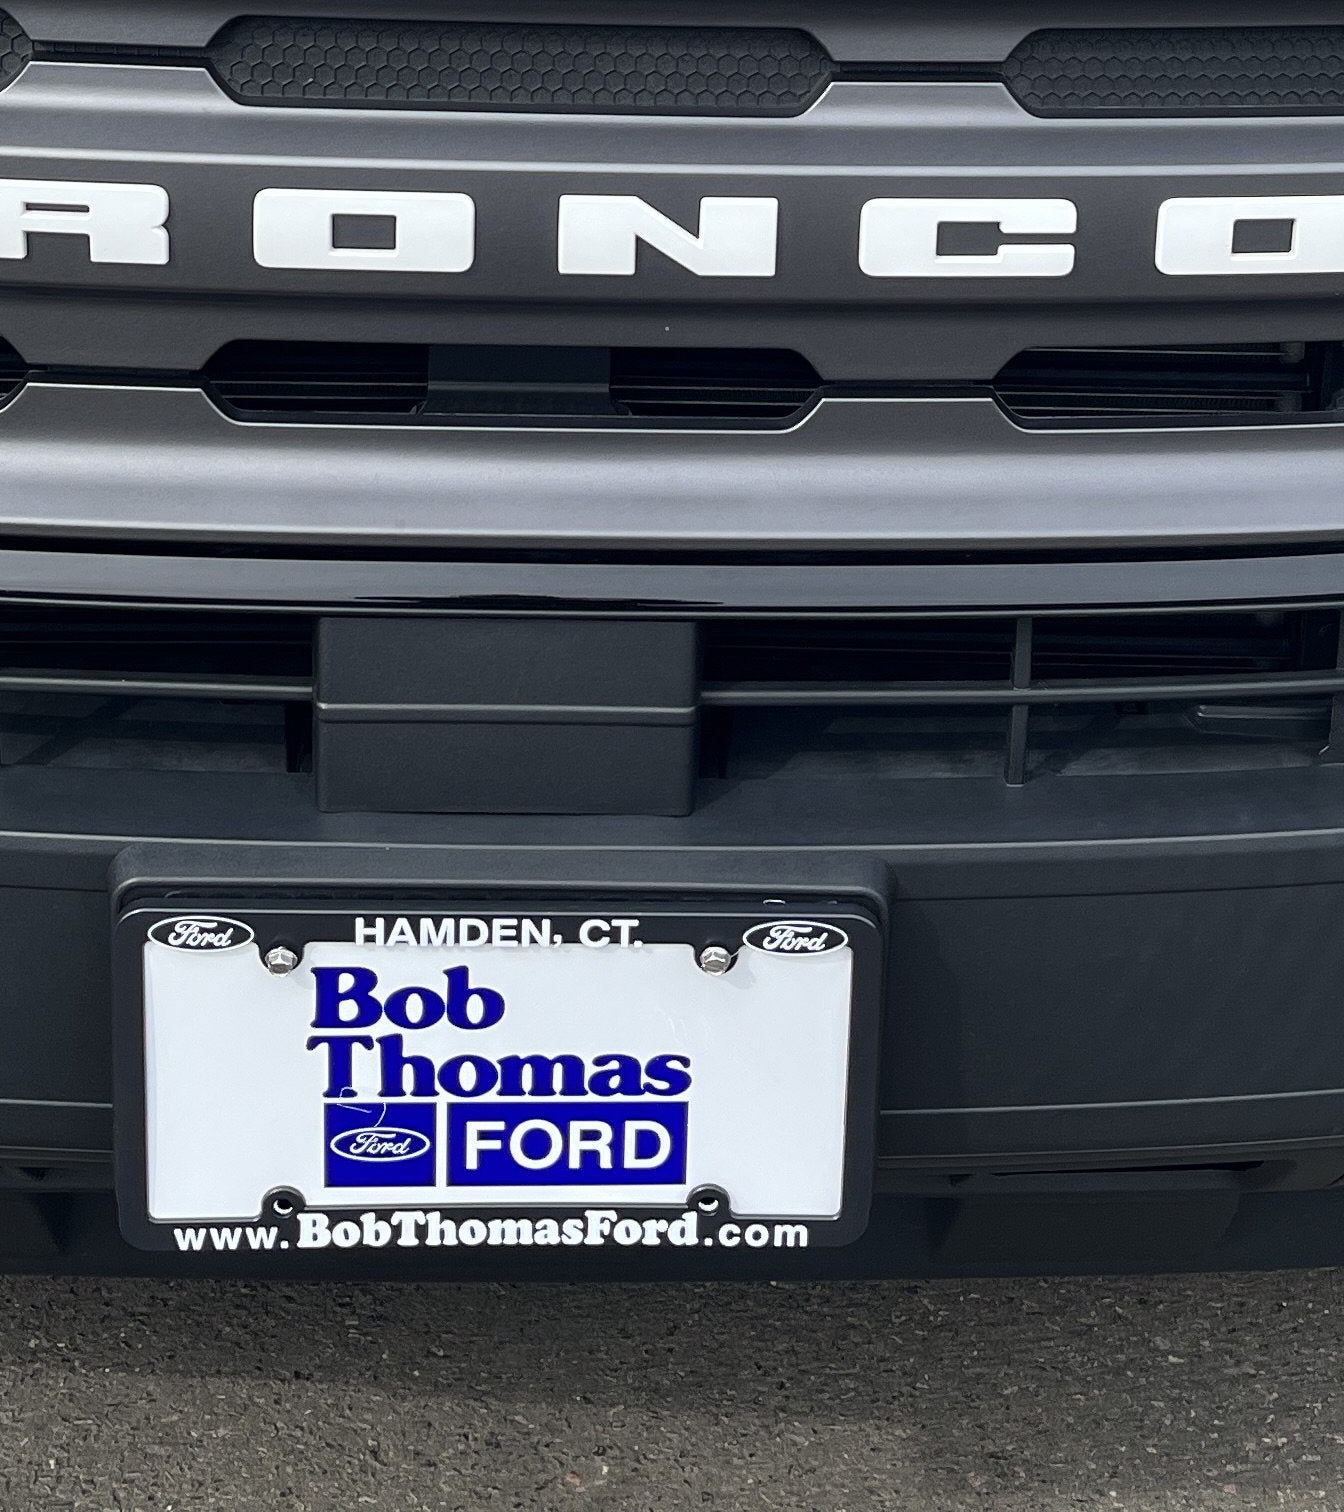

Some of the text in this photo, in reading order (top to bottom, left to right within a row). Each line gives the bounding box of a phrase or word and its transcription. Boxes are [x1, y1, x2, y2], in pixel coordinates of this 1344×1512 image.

[167, 919, 234, 947] Ford
[355, 917, 644, 948] HAMDEN, CT.
[763, 924, 829, 952] Ford
[310, 965, 506, 1030] Bob
[305, 1033, 693, 1099] Thomas
[348, 1118, 672, 1170] Ford FORD
